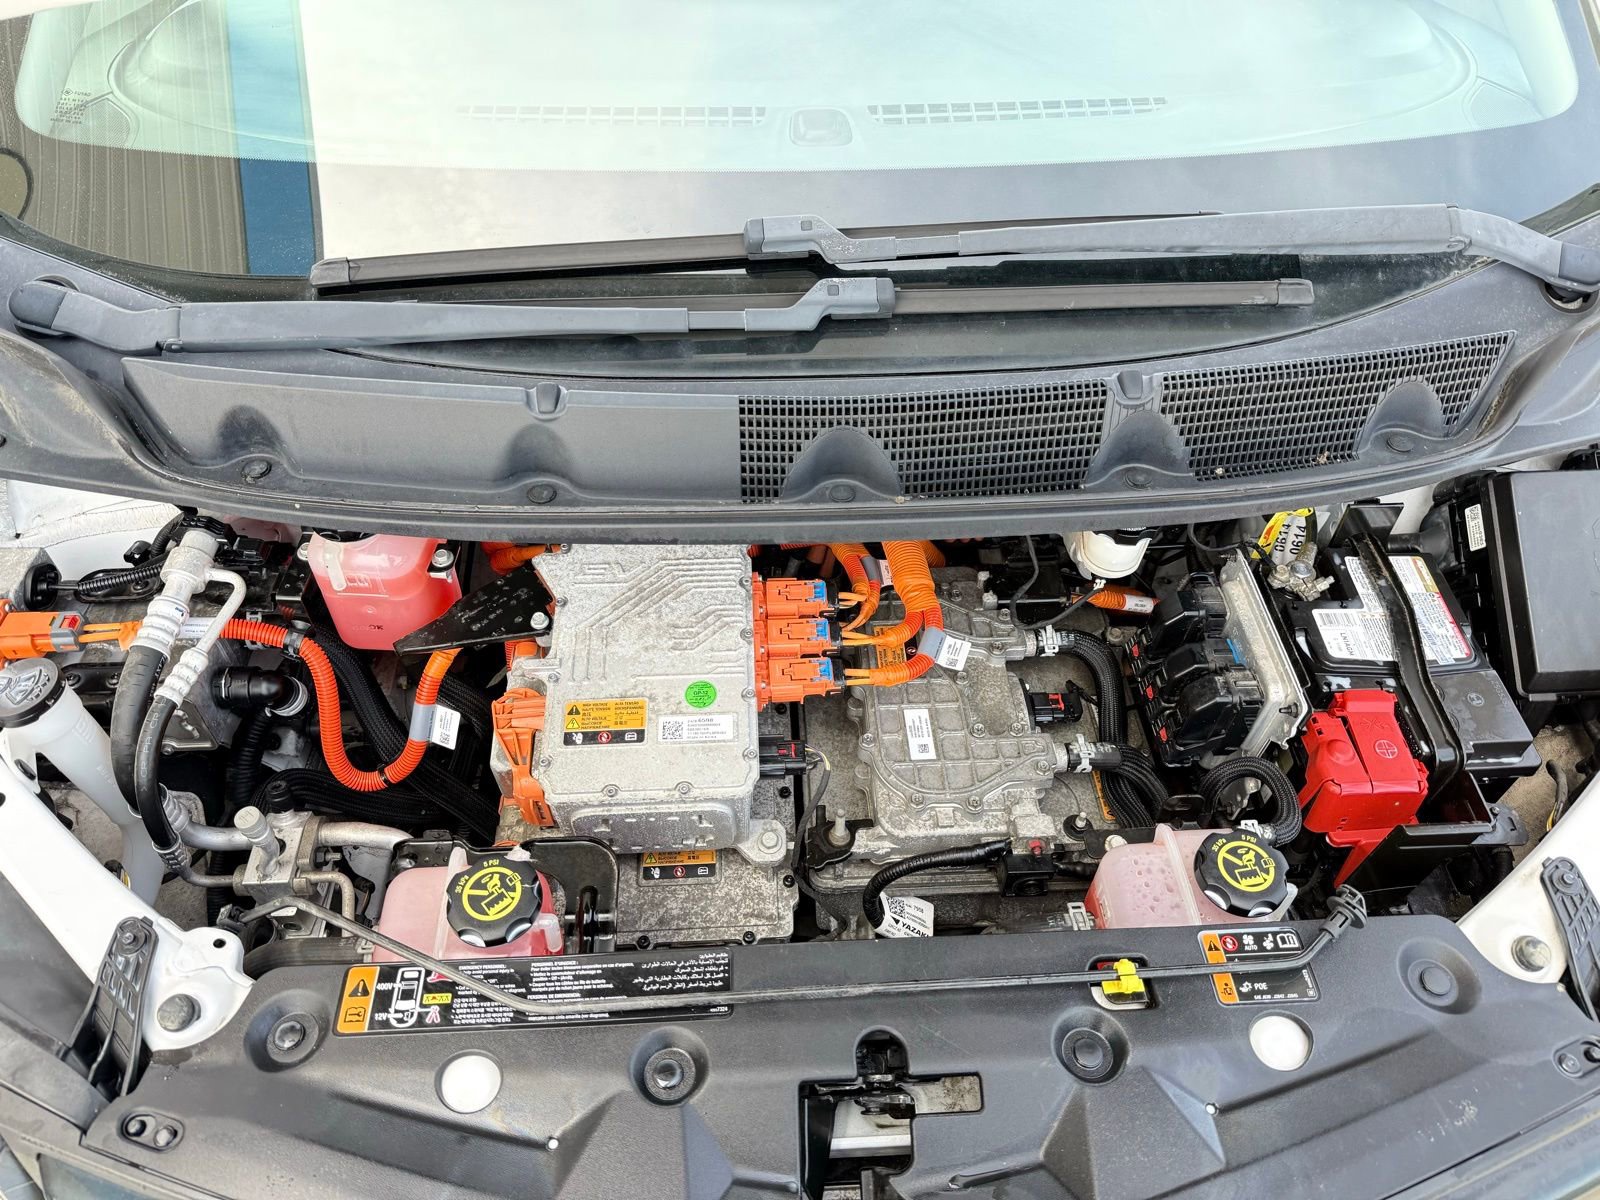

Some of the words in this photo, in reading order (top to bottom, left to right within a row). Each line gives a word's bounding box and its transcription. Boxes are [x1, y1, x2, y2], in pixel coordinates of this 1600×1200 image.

[1275, 523, 1291, 552] 0614
[1290, 526, 1306, 554] 0614
[1216, 838, 1227, 846] kPa
[458, 875, 469, 885] kPa
[1254, 982, 1268, 990] POE
